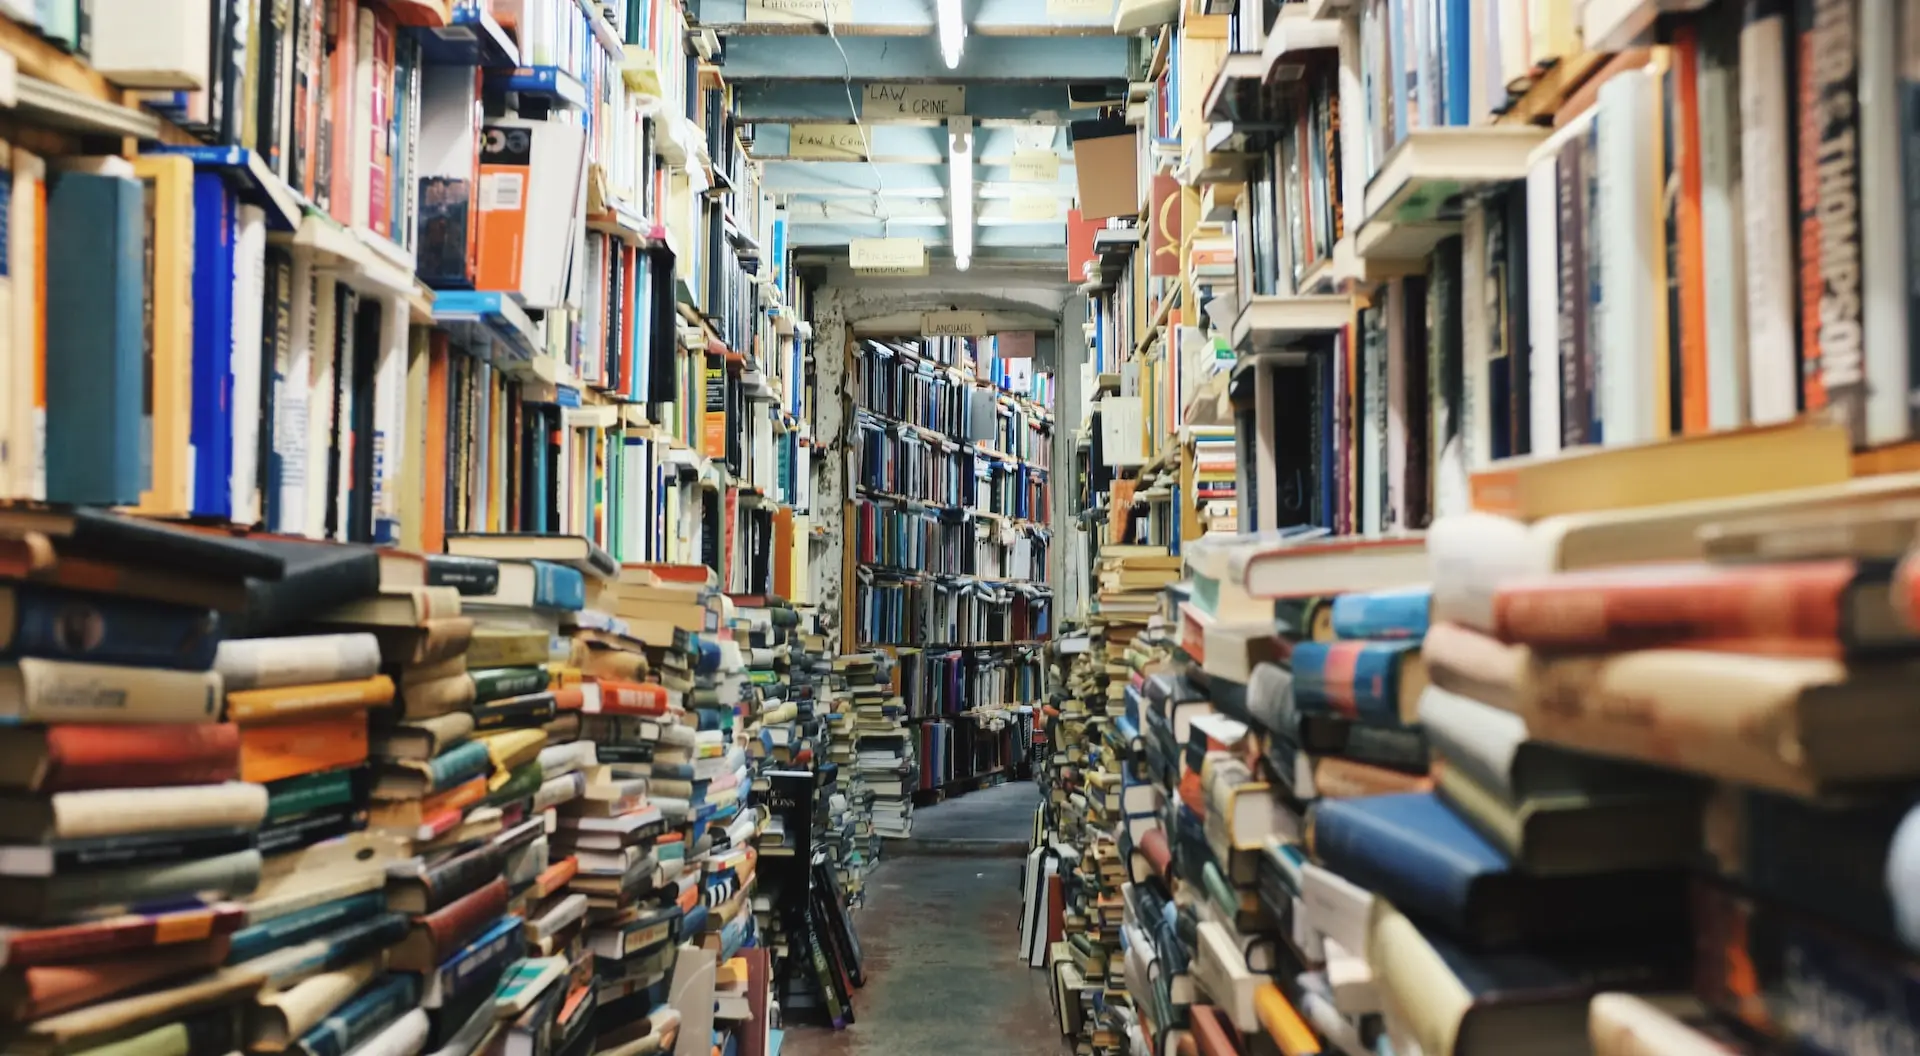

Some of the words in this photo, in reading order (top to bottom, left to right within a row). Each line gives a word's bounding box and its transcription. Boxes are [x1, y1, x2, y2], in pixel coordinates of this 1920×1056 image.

[871, 85, 907, 100] LAW
[899, 102, 905, 112] &
[913, 100, 948, 113] CRIME
[799, 133, 823, 145] LAW
[830, 134, 836, 147] &
[1817, 131, 1862, 386] THOMPSON
[928, 316, 973, 333] LANGUAGES
